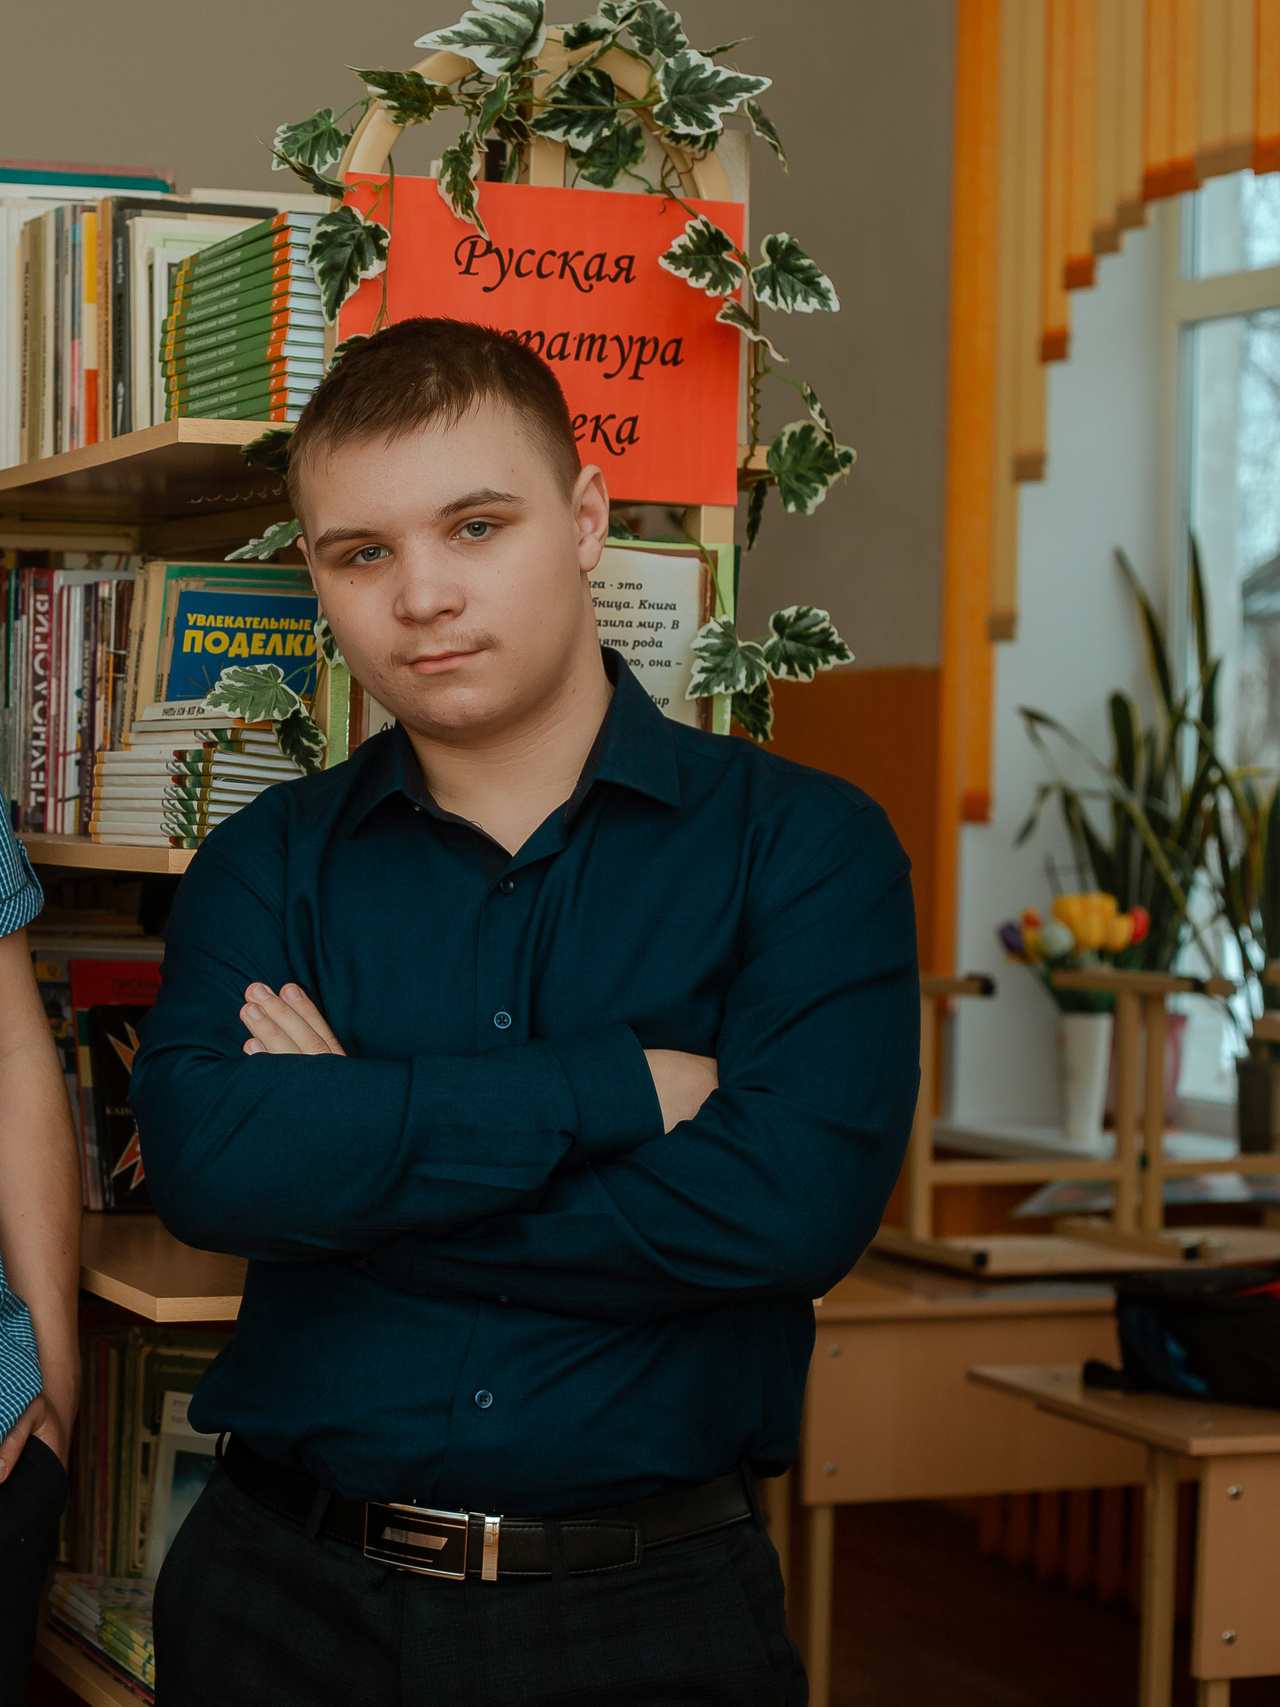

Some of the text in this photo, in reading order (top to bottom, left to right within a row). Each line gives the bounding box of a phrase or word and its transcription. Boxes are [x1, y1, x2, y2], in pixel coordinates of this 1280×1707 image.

[454, 234, 637, 293] Русская
[617, 582, 643, 590] это
[638, 599, 677, 611] Книга
[187, 613, 312, 631] УВЛЕКАТЕЛЬНЫЕ
[636, 620, 666, 633] мир.
[671, 619, 680, 630] В
[182, 629, 318, 658] ПОДЕЛКИ
[632, 636, 663, 650] рода
[649, 659, 672, 667] она
